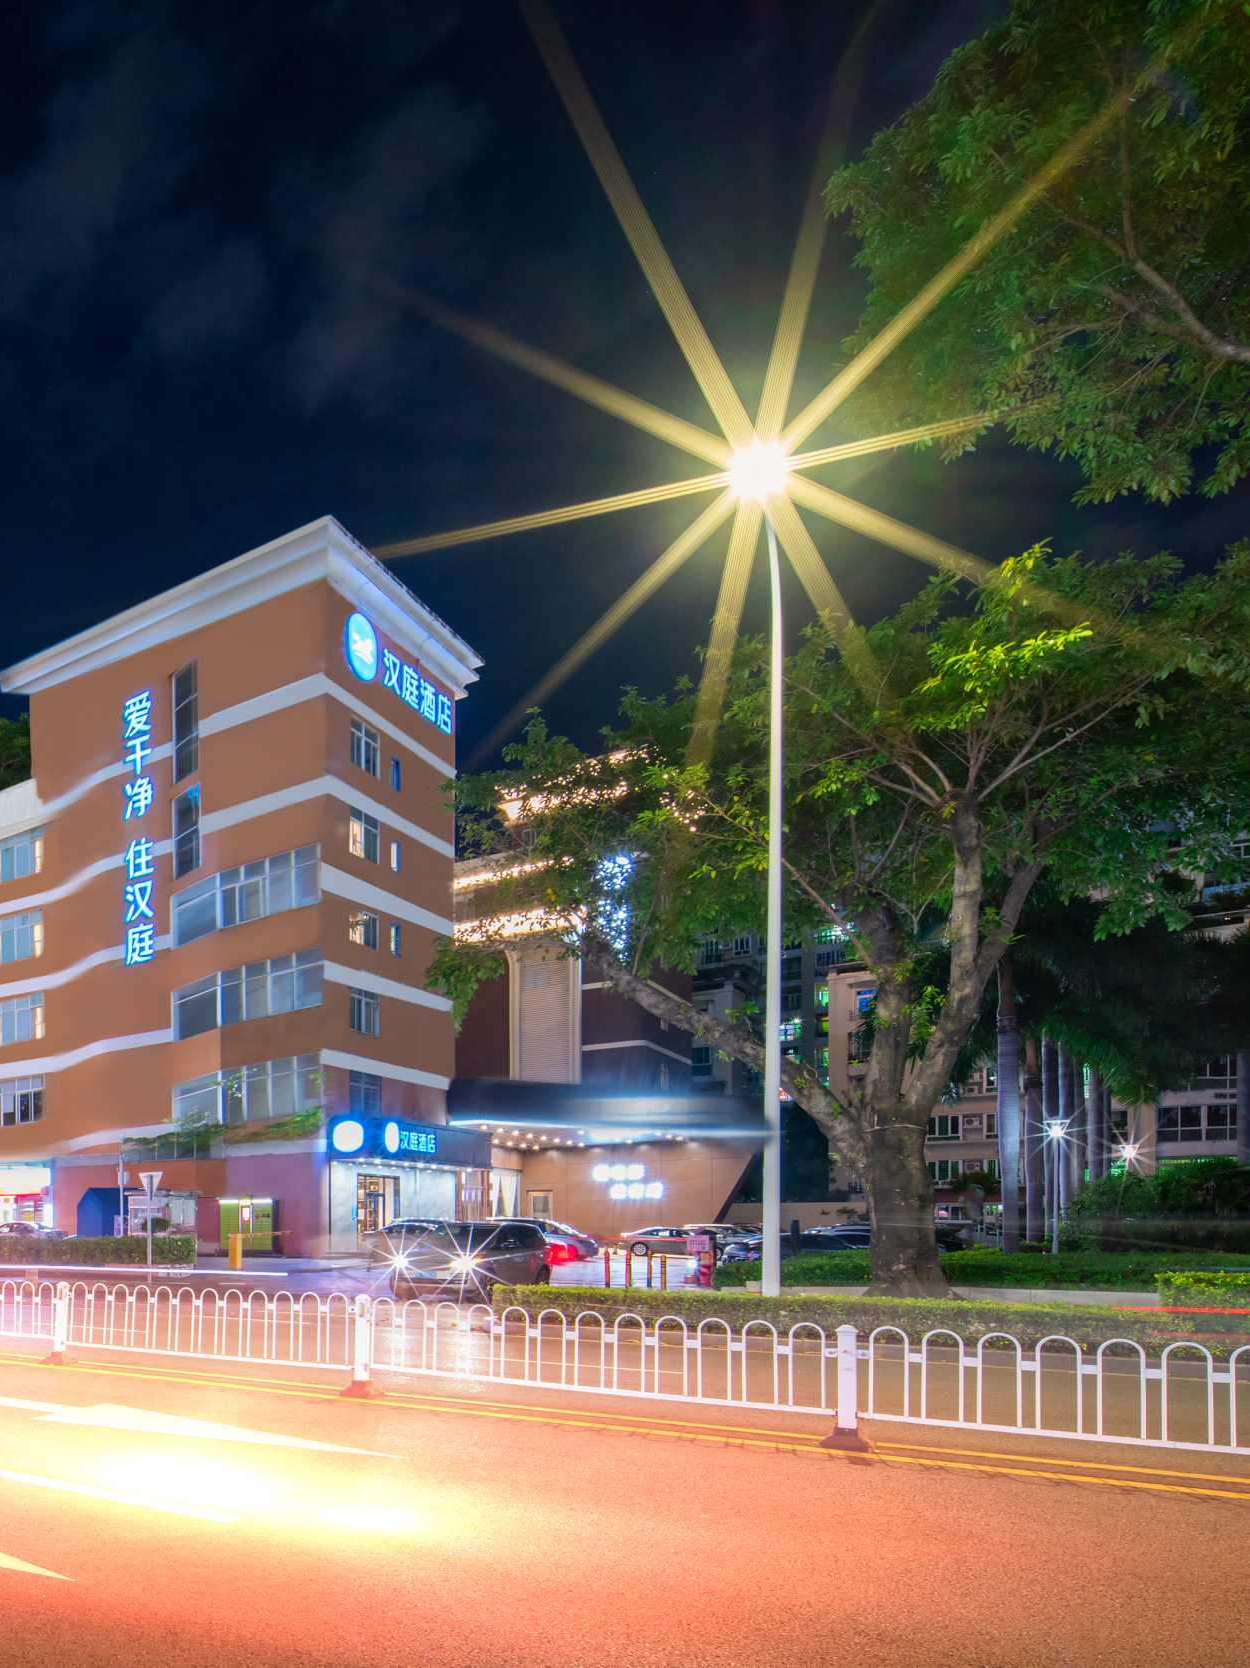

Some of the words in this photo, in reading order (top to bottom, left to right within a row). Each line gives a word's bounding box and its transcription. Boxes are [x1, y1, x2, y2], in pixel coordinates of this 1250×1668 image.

[382, 647, 453, 735] 汉庭酒店
[124, 690, 153, 820] 爱干净
[124, 836, 154, 966] 住汉庭
[400, 1131, 436, 1152] 汉庭酒店
